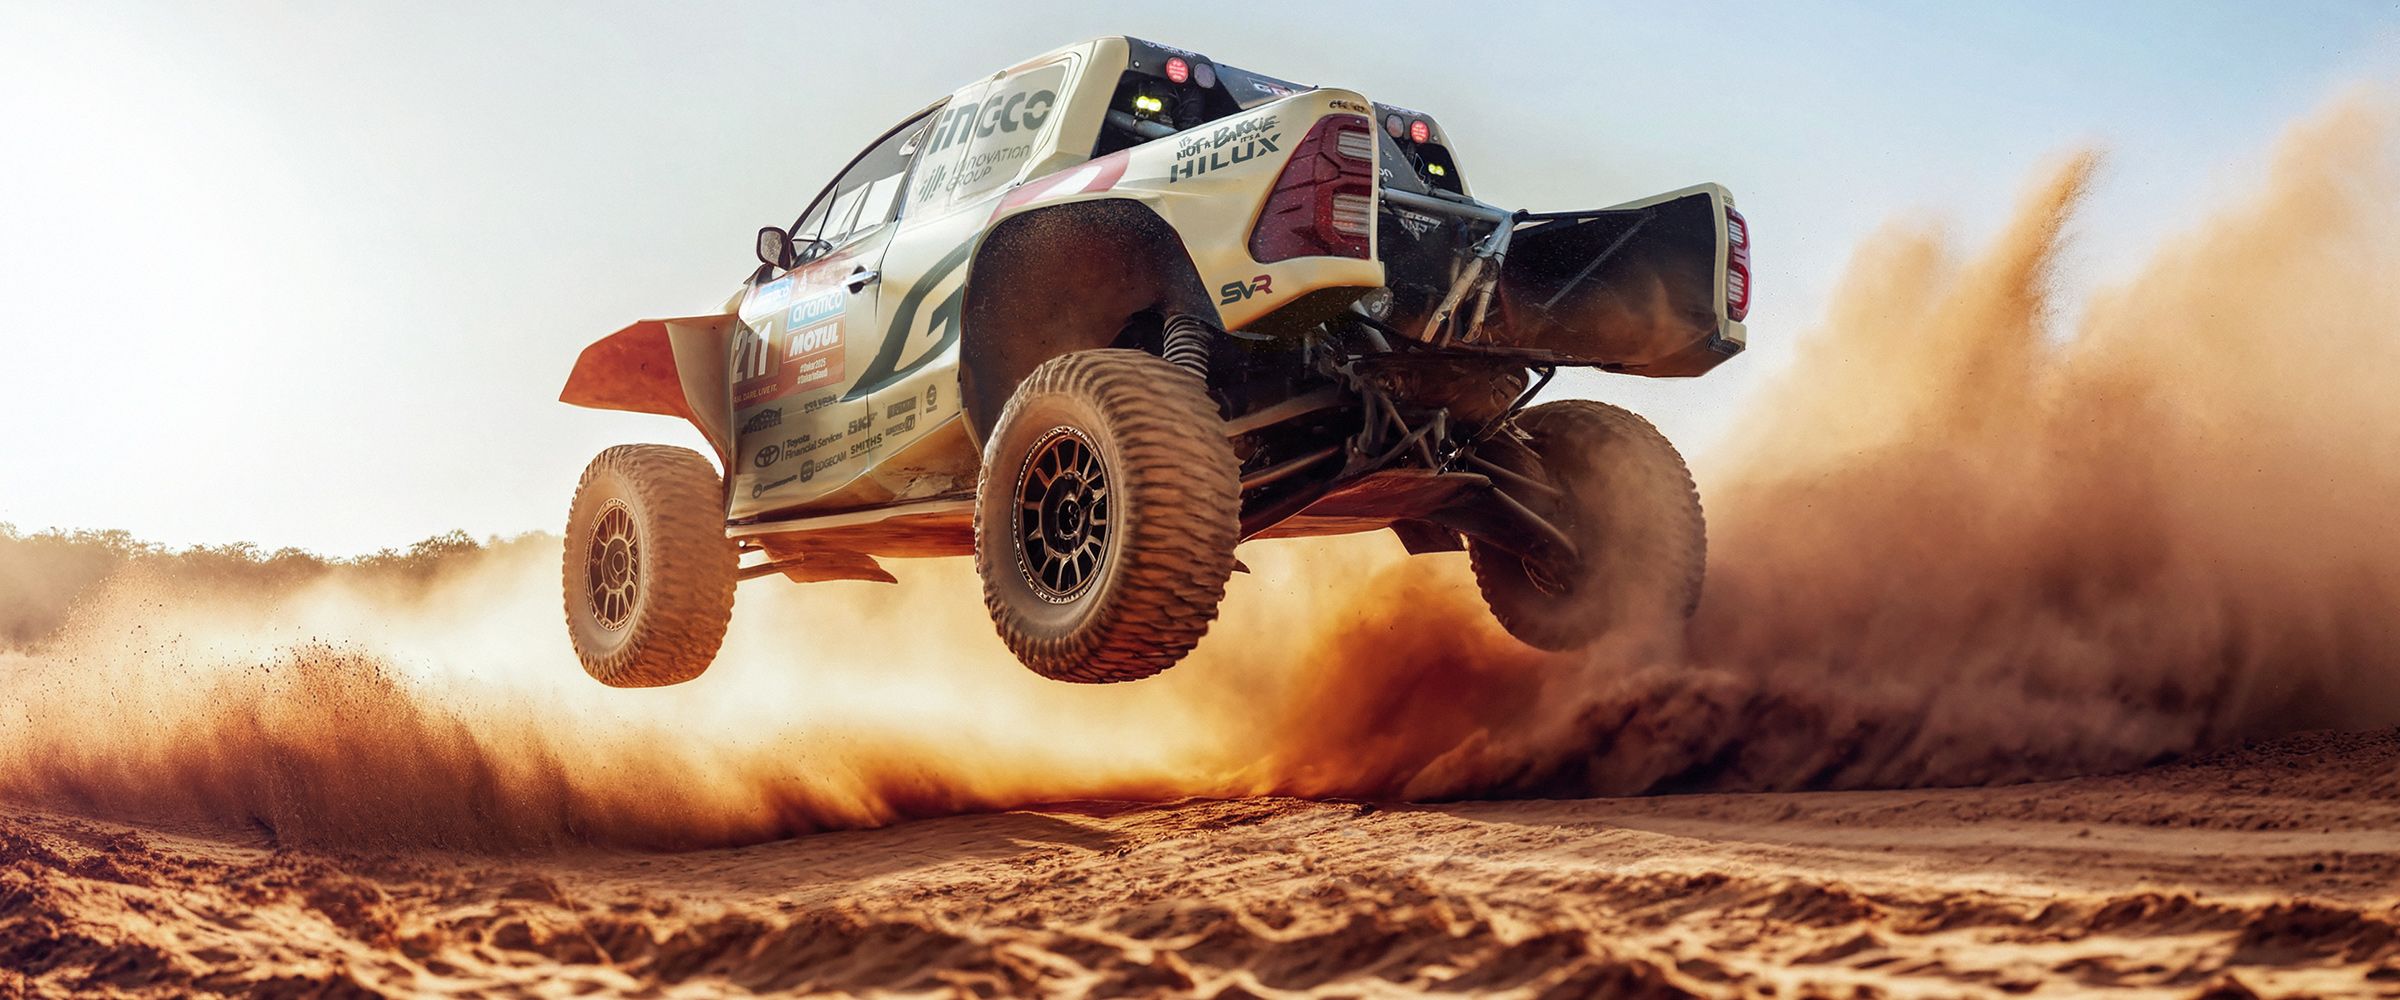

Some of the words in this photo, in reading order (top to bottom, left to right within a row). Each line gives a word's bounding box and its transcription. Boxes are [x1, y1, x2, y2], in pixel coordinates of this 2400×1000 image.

[1169, 132, 1281, 184] HILUX
[1176, 137, 1206, 161] NOT
[946, 166, 992, 192] GROUP
[1219, 274, 1273, 306] SVR
[792, 291, 844, 323] aramco
[733, 320, 772, 382] 211
[789, 322, 839, 357] MOTUL
[848, 412, 878, 435] SKF
[785, 440, 817, 460] Financial
[818, 432, 844, 448] Services
[786, 434, 810, 448] Toyota
[850, 433, 882, 455] SMITHS
[815, 451, 847, 472] EDGECAM
